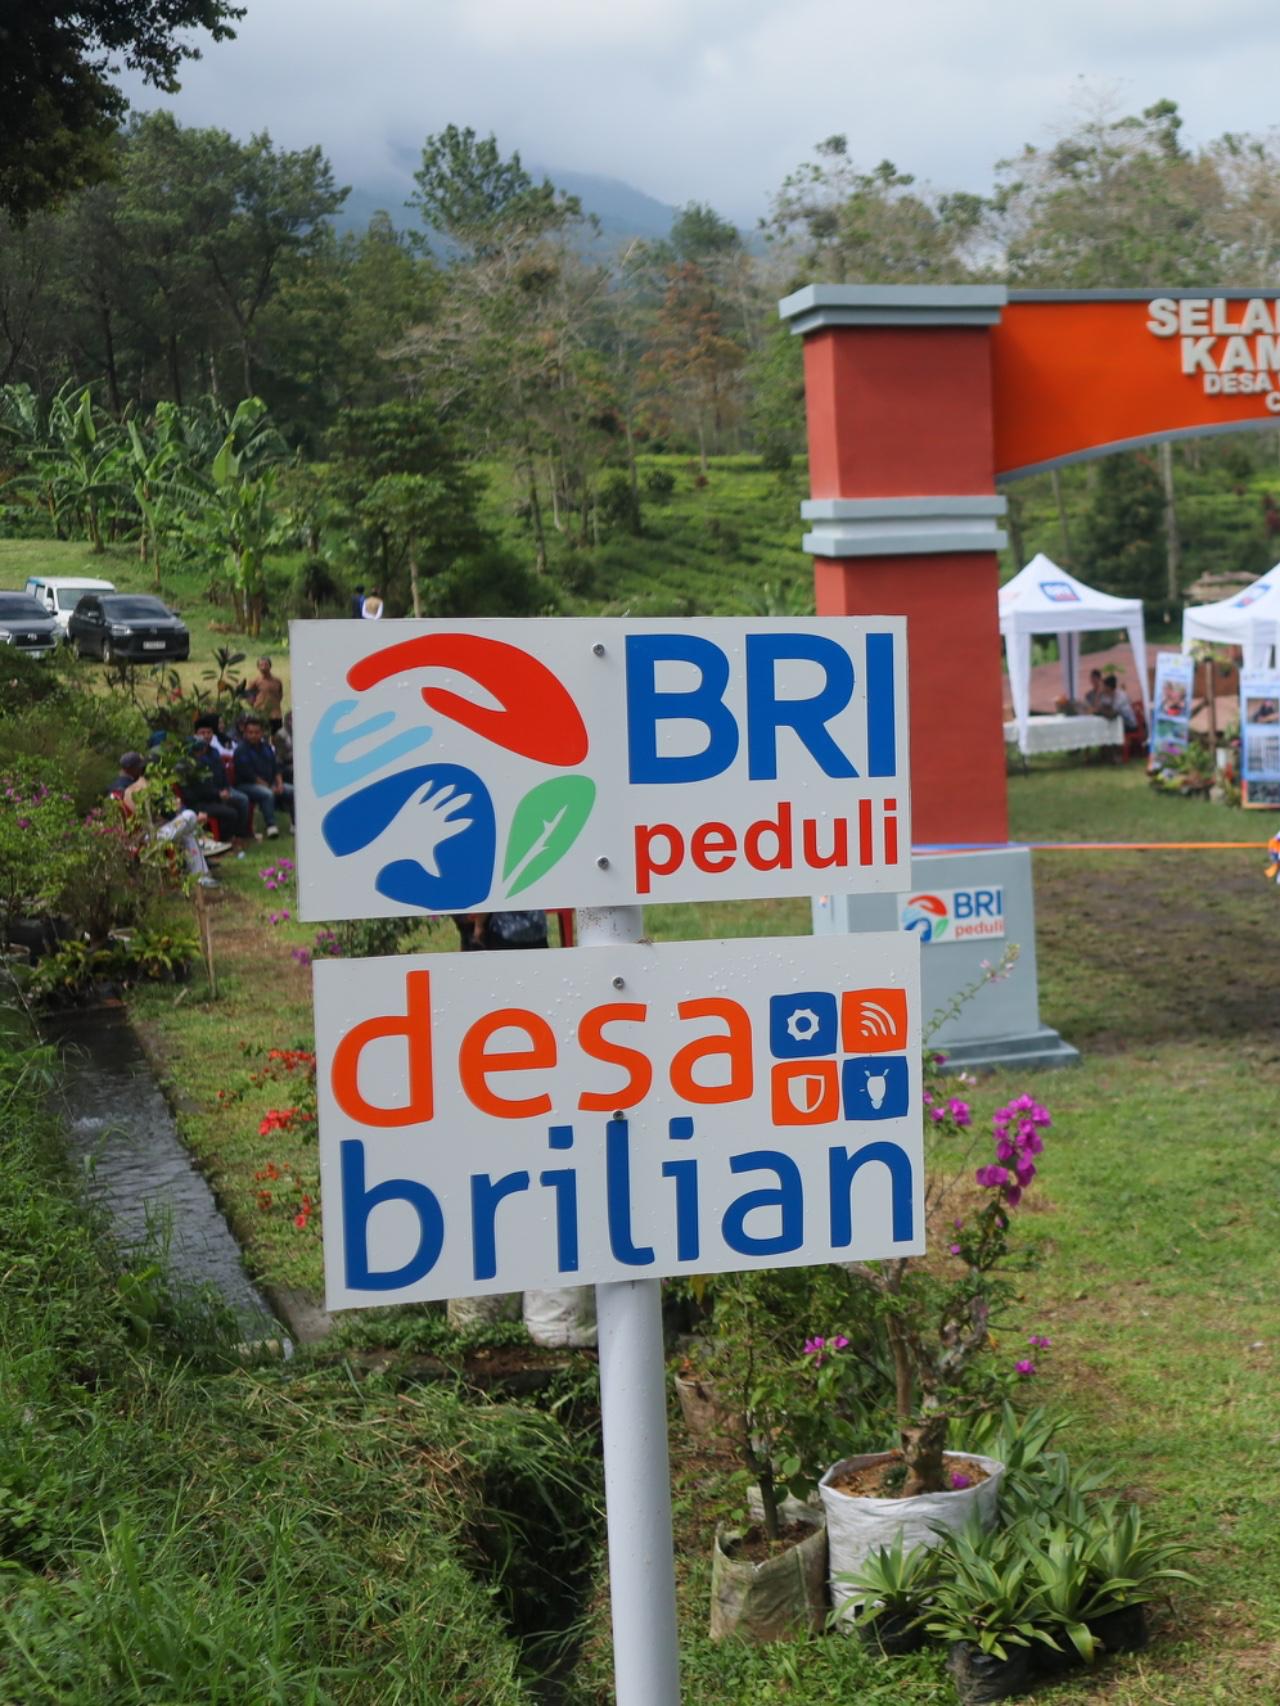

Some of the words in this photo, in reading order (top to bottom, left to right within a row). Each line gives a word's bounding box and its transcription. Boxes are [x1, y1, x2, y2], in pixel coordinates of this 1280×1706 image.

[1203, 371, 1272, 394] DESA
[624, 632, 897, 785] BRI
[634, 798, 899, 894] peduli
[953, 890, 1003, 919] BRI
[954, 920, 1004, 939] peduli
[331, 970, 755, 1128] desa
[340, 1116, 914, 1291] brilian
